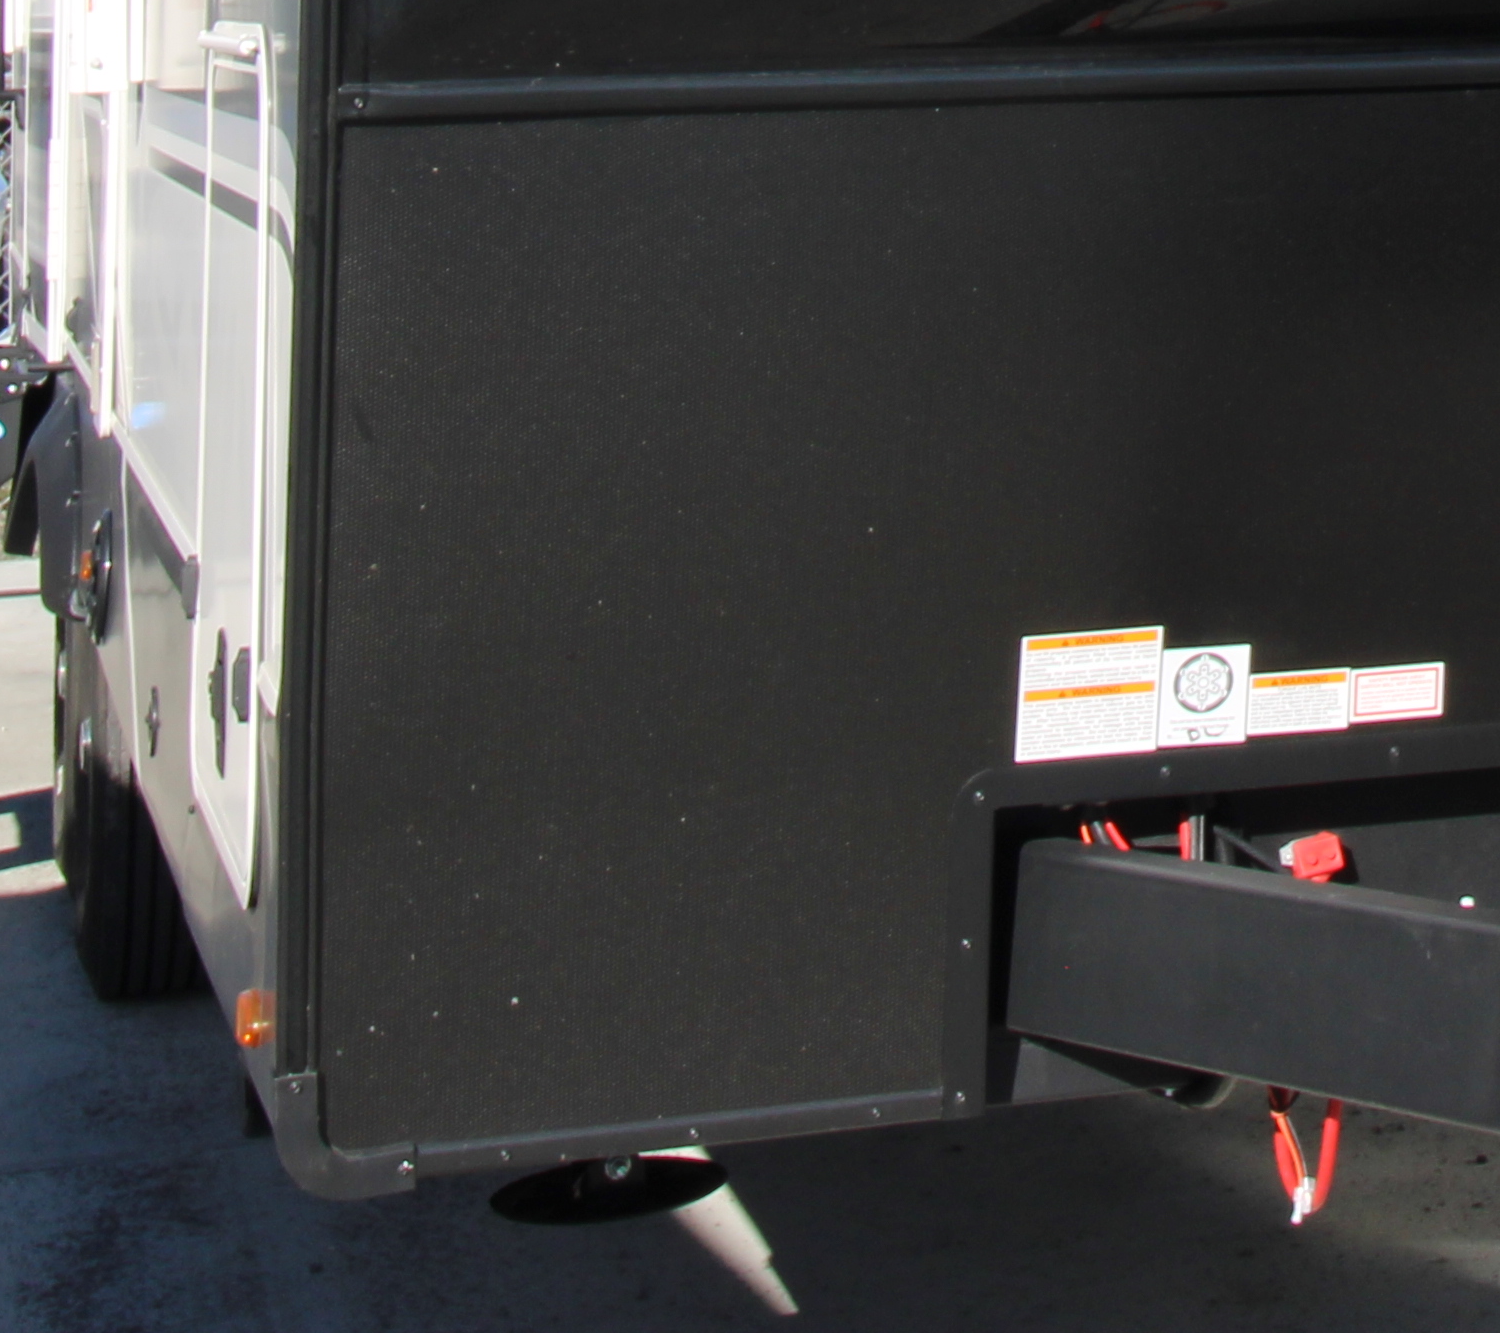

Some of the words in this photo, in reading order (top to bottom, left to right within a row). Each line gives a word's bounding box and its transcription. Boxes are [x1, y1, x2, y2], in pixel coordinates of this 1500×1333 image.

[1075, 634, 1124, 645] WARNING
[1281, 674, 1329, 685] WARNING
[1072, 685, 1121, 696] WARNING
